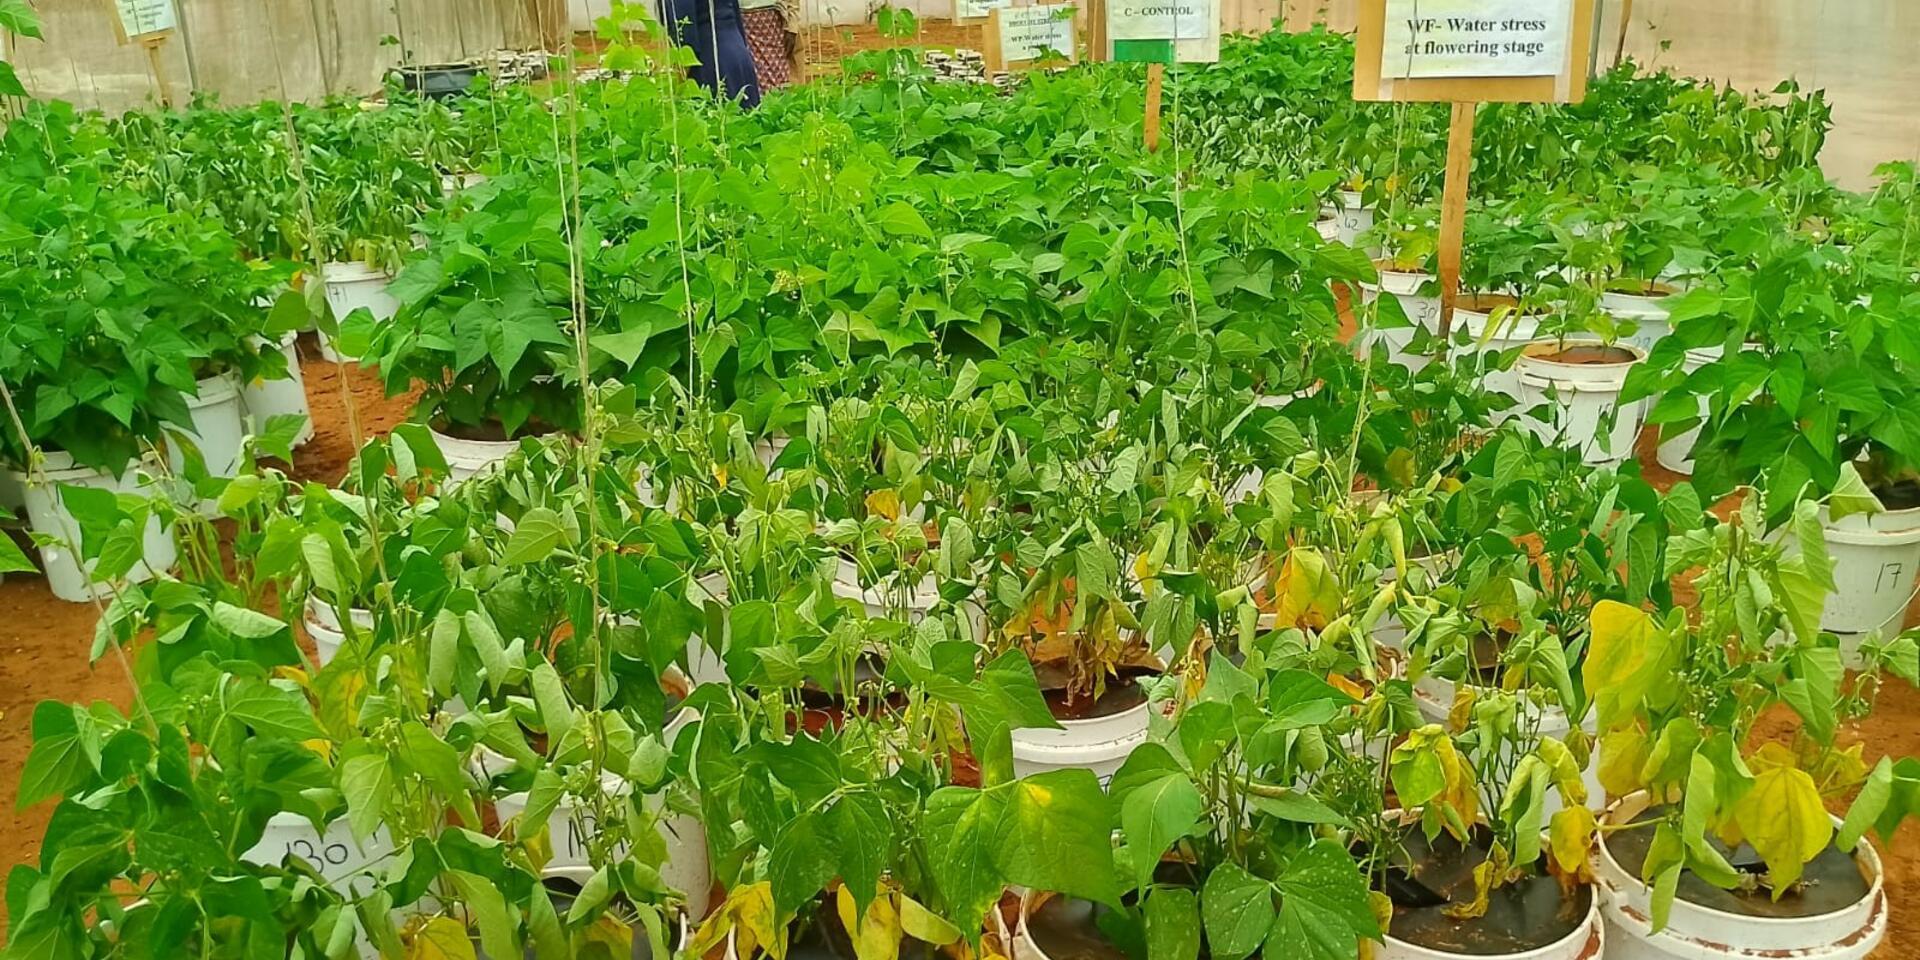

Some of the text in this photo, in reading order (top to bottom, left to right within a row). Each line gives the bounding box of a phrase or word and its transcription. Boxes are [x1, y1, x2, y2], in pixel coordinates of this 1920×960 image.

[1407, 18, 1546, 33] WF- Water stress
[1404, 40, 1545, 57] at flowering stage
[1874, 562, 1902, 594] 17
